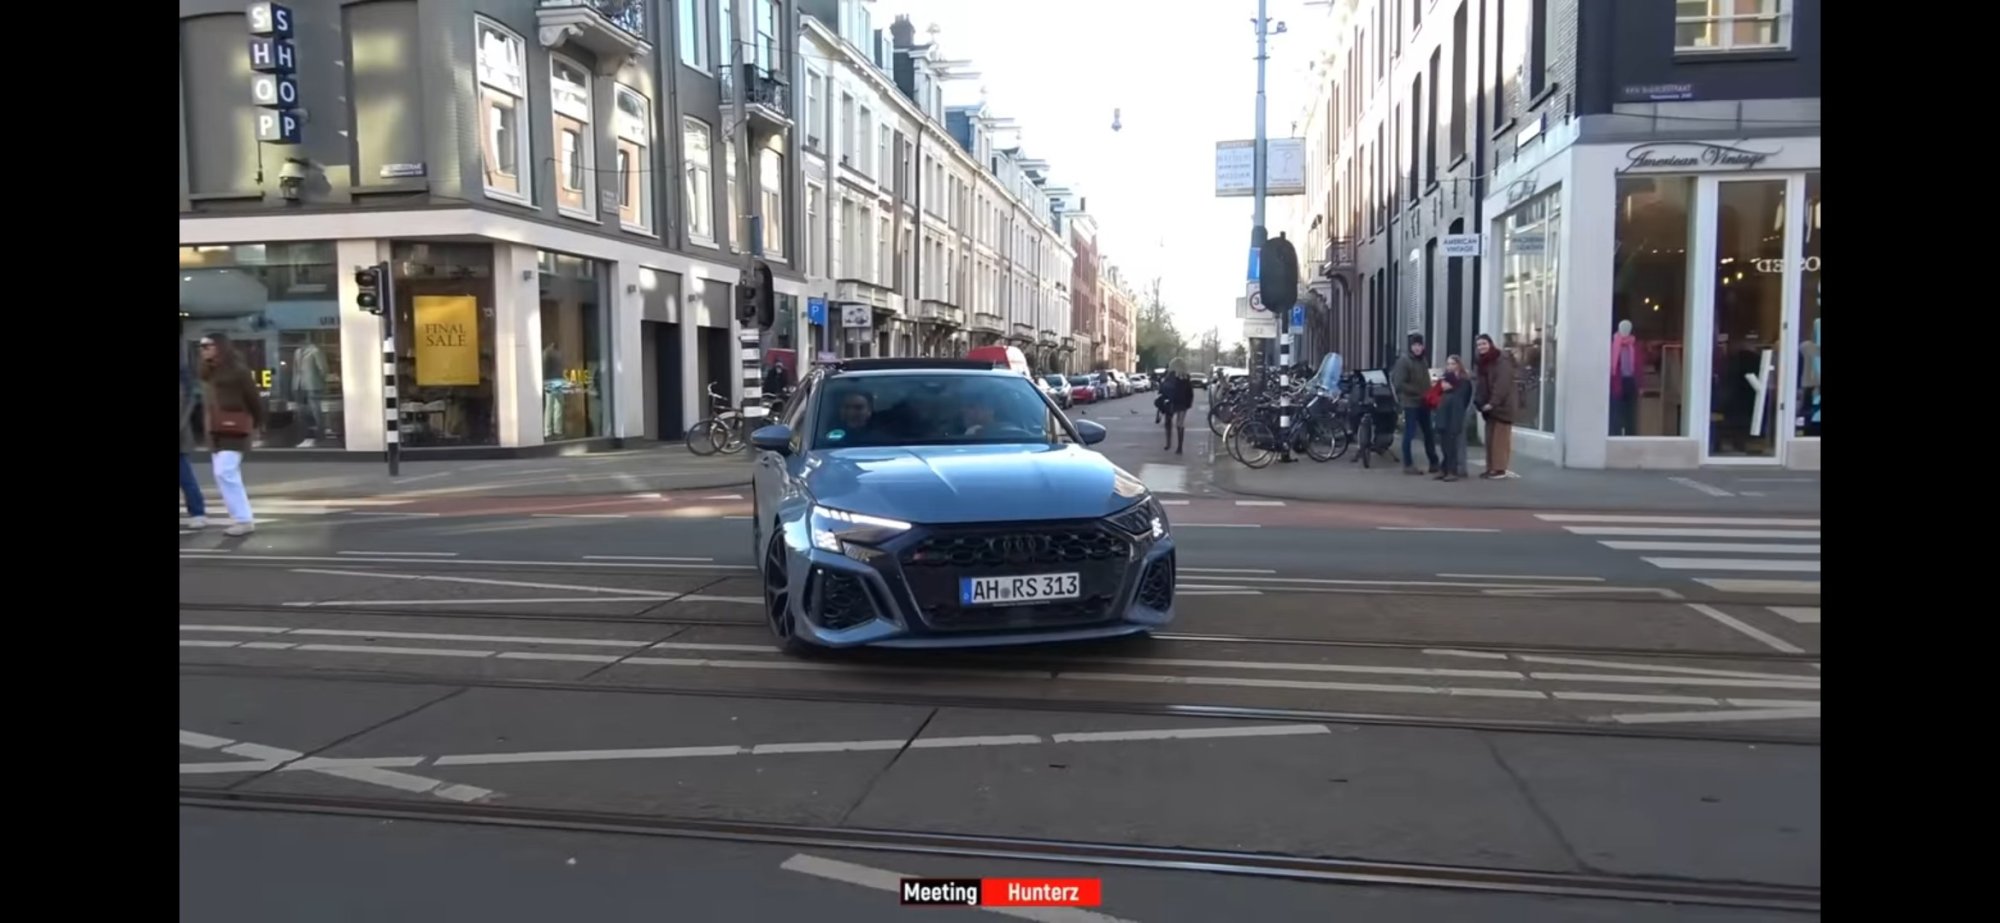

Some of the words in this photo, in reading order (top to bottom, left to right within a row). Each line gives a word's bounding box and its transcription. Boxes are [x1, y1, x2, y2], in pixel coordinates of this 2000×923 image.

[253, 6, 274, 136] SHOP
[276, 10, 296, 136] SHOP
[1626, 143, 1699, 170] American
[1701, 145, 1768, 171] Vintage
[424, 323, 466, 334] FINAL
[425, 334, 466, 347] SALE
[974, 578, 999, 600] AH
[1012, 577, 1037, 599] RS
[1043, 575, 1077, 596] 313
